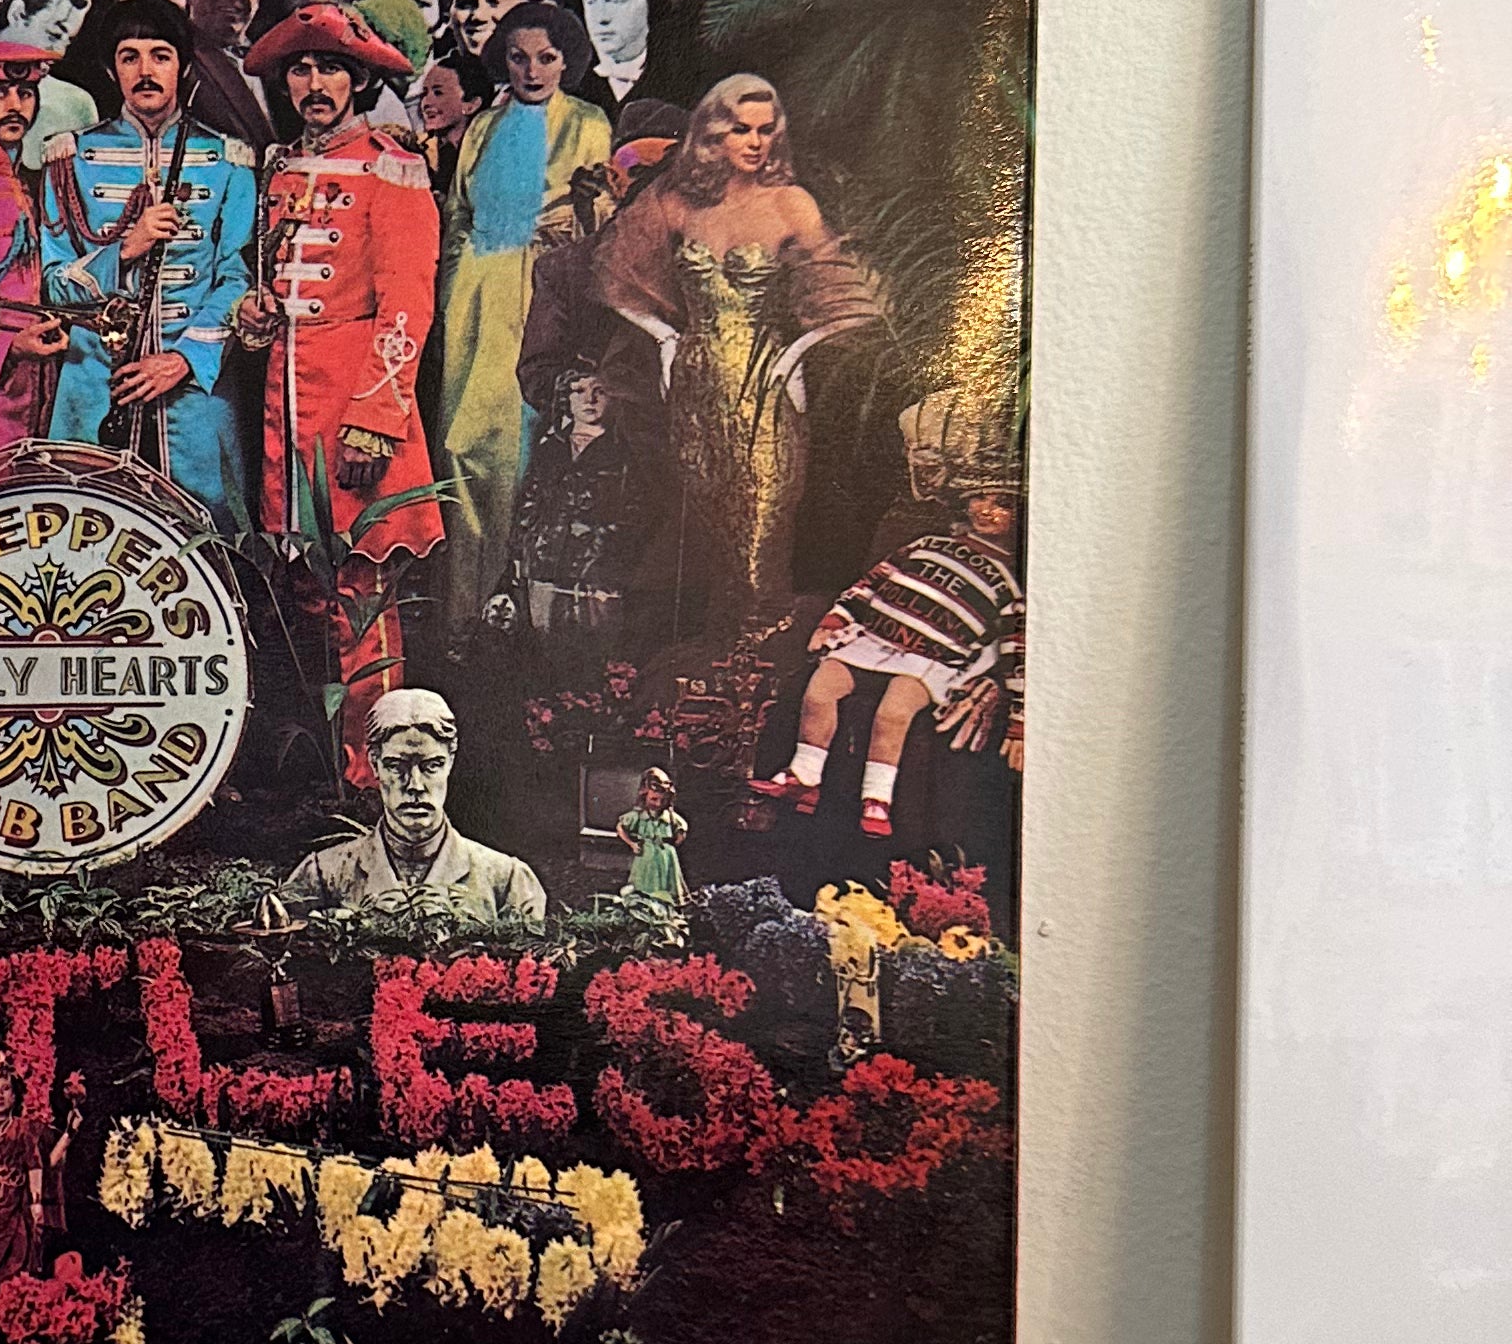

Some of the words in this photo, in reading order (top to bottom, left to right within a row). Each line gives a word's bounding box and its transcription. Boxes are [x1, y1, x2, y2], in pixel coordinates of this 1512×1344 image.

[918, 561, 968, 597] THE
[59, 654, 230, 697] HEARTS
[60, 722, 208, 845] BAND
